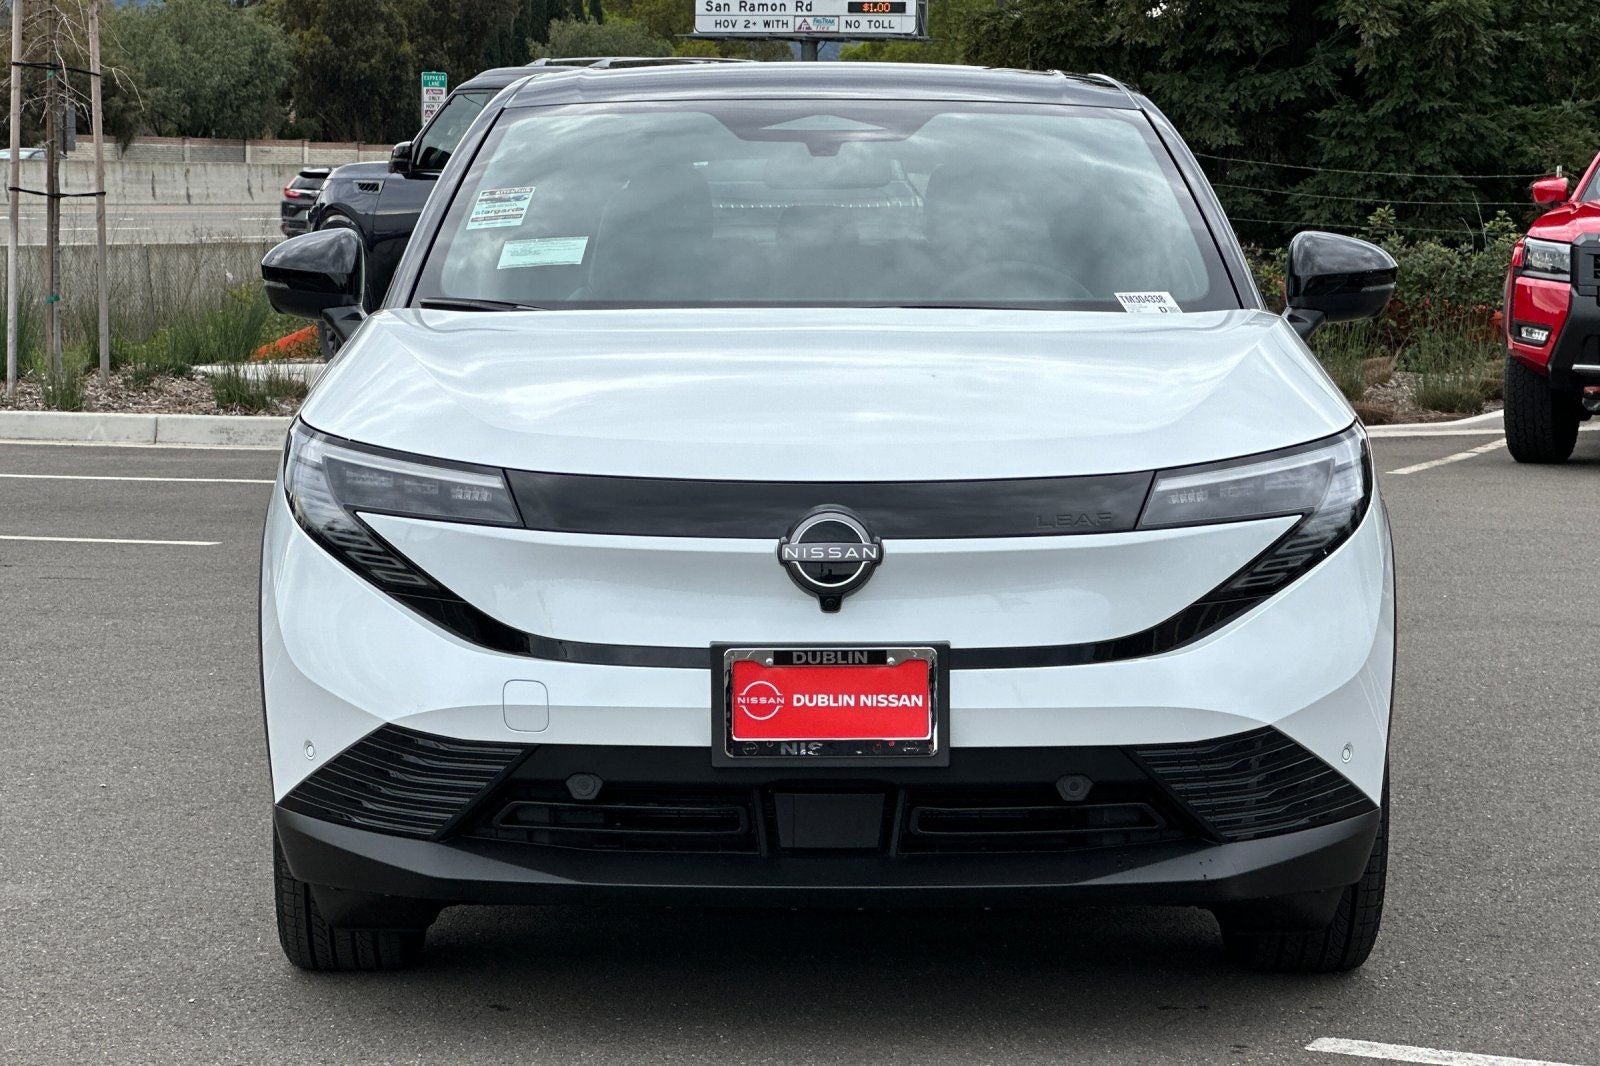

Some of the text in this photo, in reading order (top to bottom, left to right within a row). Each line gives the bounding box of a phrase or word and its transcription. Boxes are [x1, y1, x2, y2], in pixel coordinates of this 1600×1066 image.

[705, 0, 813, 12] San Ramon Rd
[862, 2, 891, 12] $1.00
[714, 19, 789, 29] HOV 2+ WITH
[845, 19, 895, 29] NO TOLL
[1036, 511, 1113, 528] LEAF
[784, 546, 877, 559] NISSAN
[791, 650, 869, 665] DUBLIN
[737, 696, 785, 705] NISSAN
[792, 693, 924, 708] DUBLIN NISSAN
